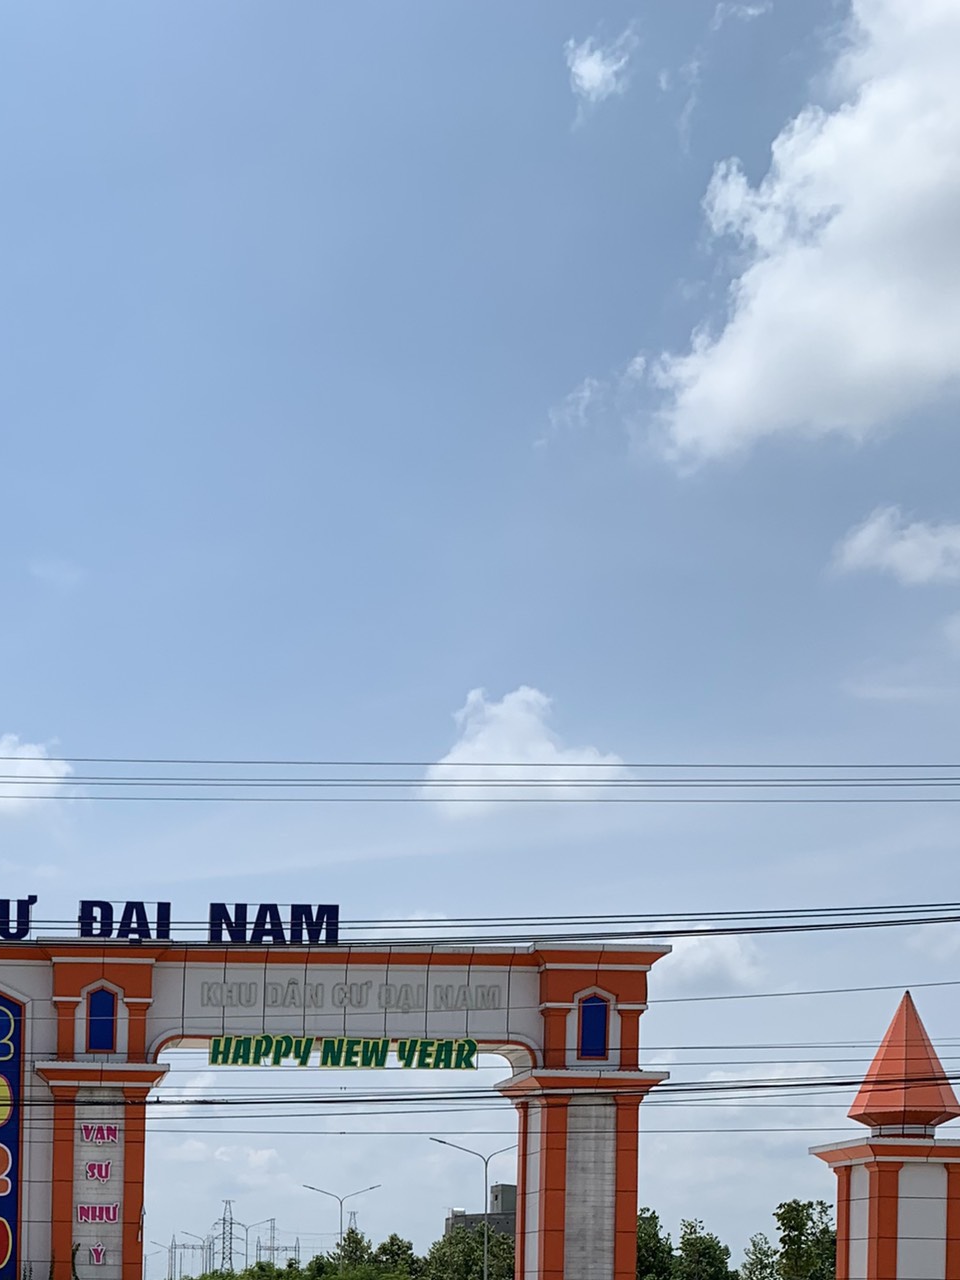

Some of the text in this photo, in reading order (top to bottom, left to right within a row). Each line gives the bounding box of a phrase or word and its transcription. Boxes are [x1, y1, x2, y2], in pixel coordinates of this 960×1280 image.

[78, 900, 171, 944] ĐẠI
[209, 903, 340, 943] NAM
[200, 981, 258, 1008] KHU
[265, 978, 325, 1008] DÂN
[331, 980, 373, 1008] CƯ
[433, 984, 502, 1010] NAM
[209, 1034, 478, 1069] HAPPY NEW YEAR
[81, 1124, 119, 1145] VẠN
[86, 1161, 112, 1184] SỰ
[77, 1203, 120, 1223] NHƯ
[90, 1242, 106, 1265] Ý
